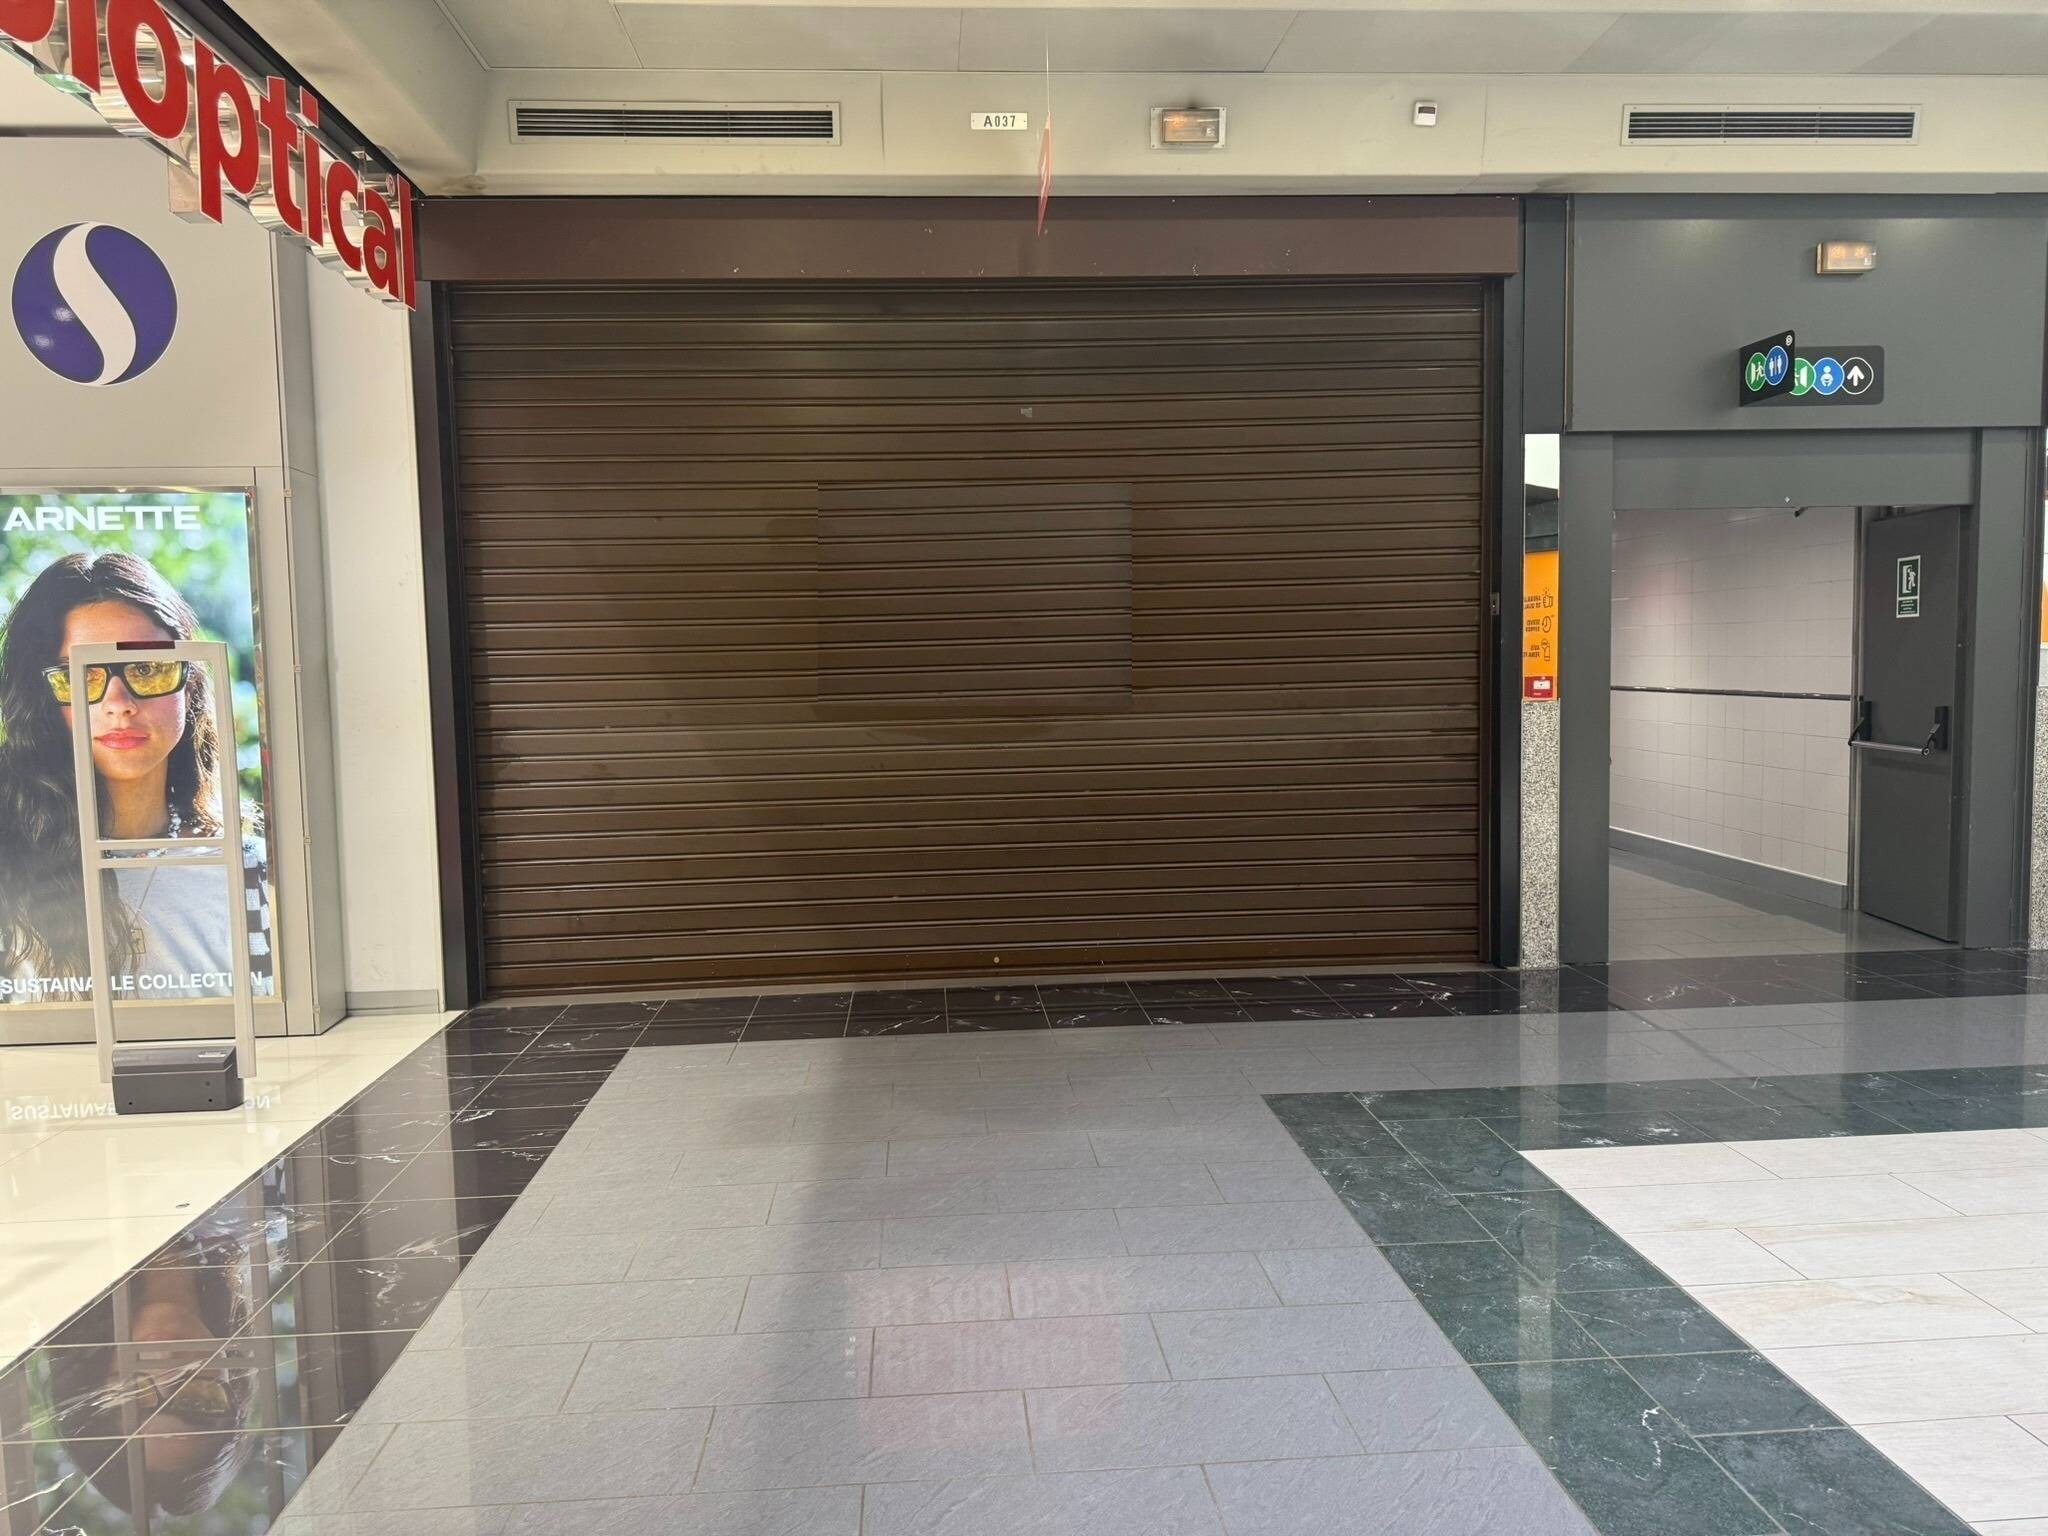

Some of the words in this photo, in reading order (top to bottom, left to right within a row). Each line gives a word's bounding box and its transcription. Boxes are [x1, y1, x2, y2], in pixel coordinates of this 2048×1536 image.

[983, 115, 1016, 128] A037
[3, 505, 201, 531] ARNETTE
[0, 975, 135, 994] SUSTAINALE
[138, 971, 262, 990] COLLECTIN
